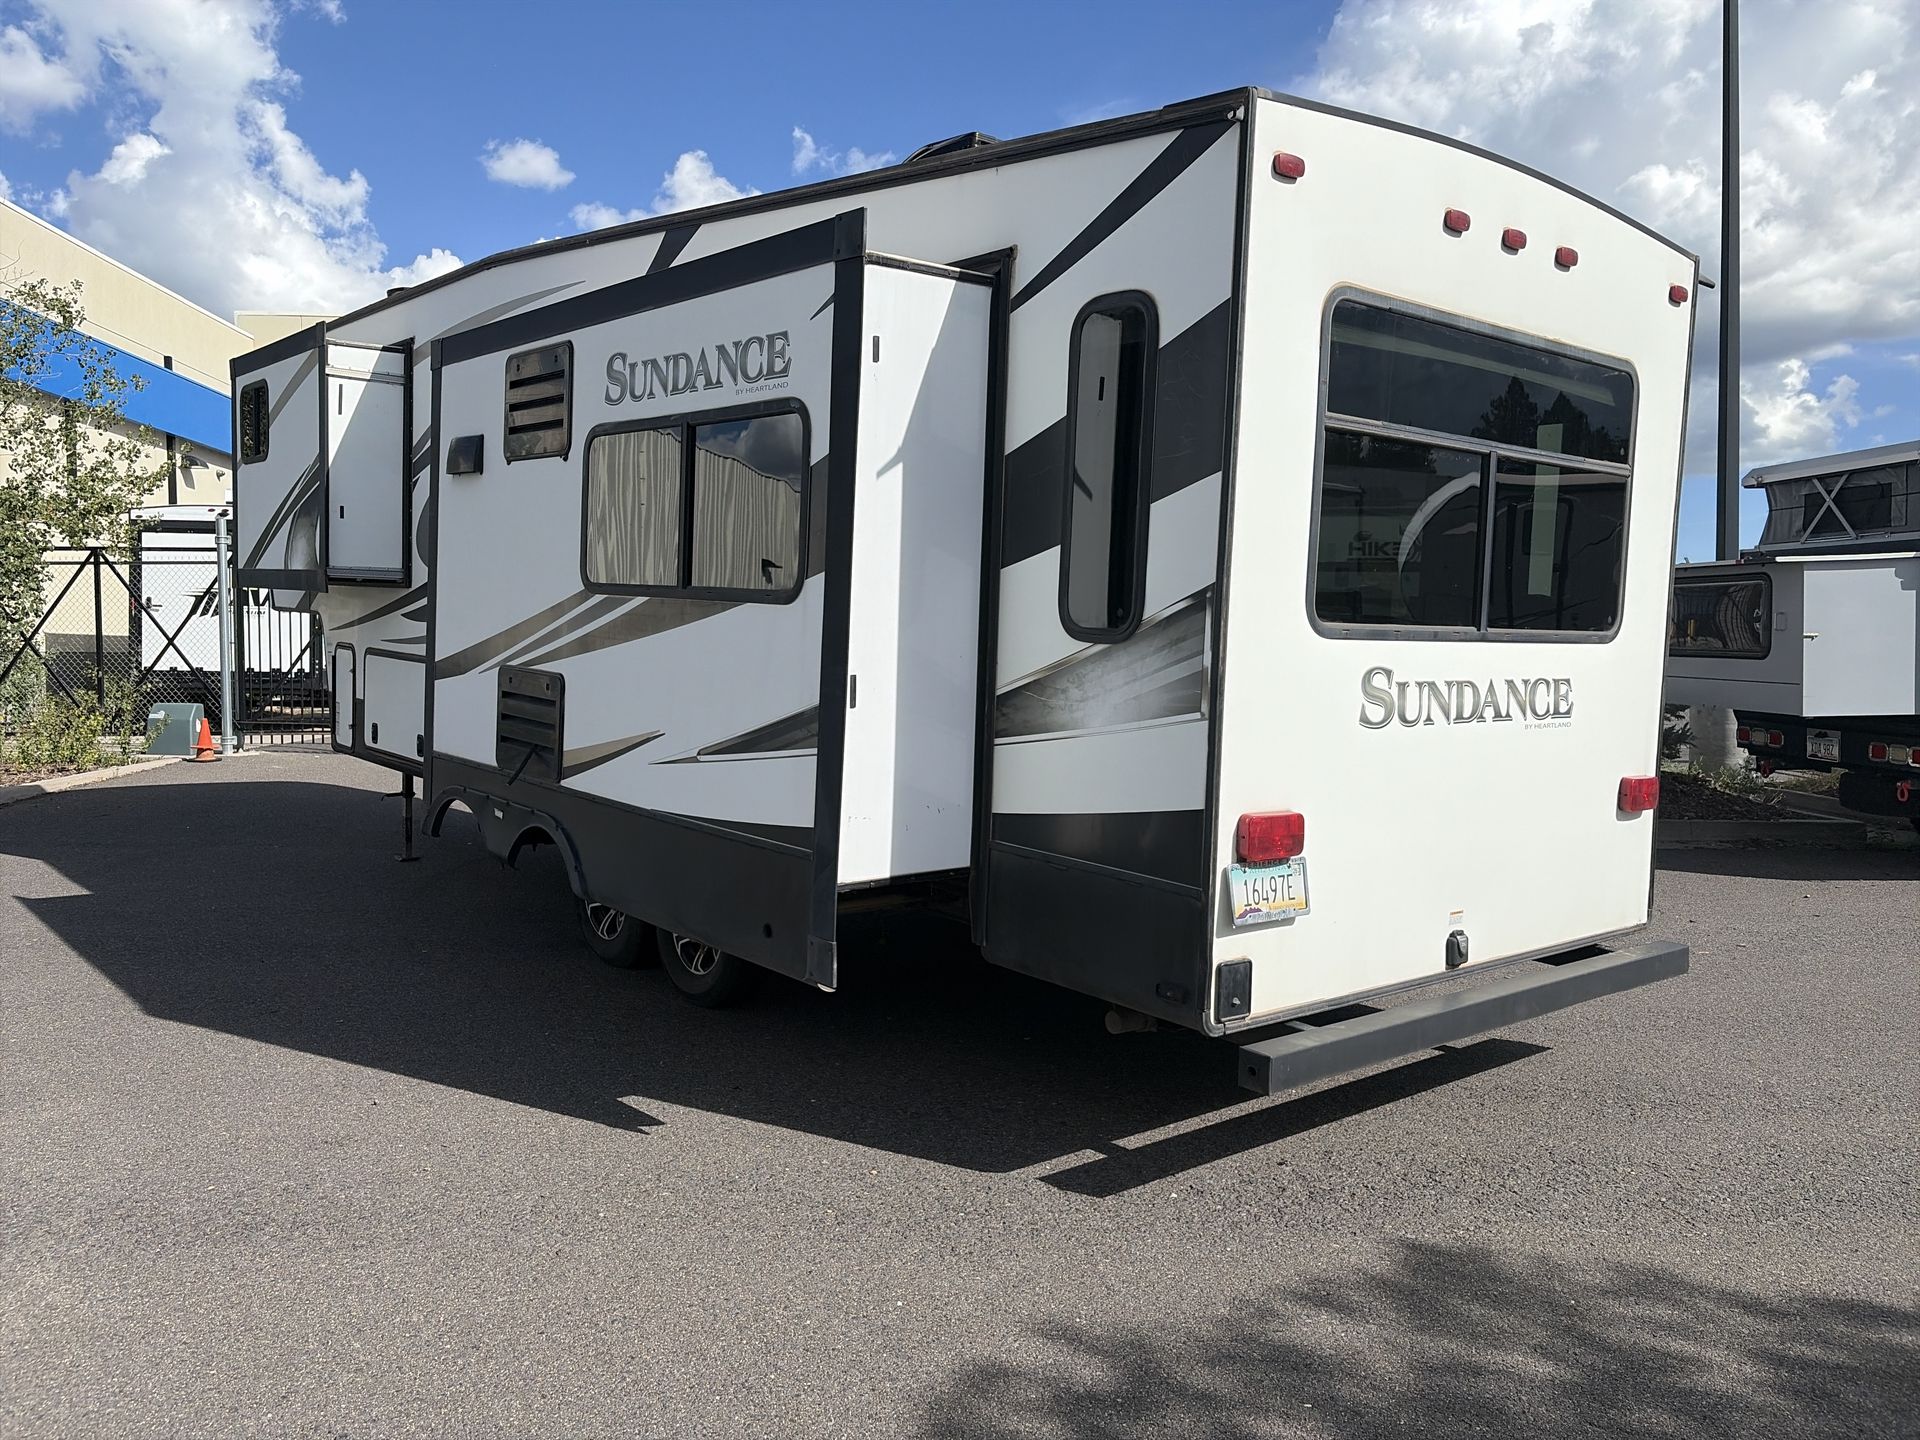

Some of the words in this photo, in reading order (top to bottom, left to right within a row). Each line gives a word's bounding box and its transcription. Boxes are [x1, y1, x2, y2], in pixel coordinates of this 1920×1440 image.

[604, 330, 792, 405] SUNDANCE
[735, 388, 744, 396] BY
[745, 381, 789, 394] HEARTLAND
[1359, 666, 1574, 729] SUNDANCE
[1534, 721, 1572, 729] HEARTLAND
[1243, 873, 1296, 907] 16497E
